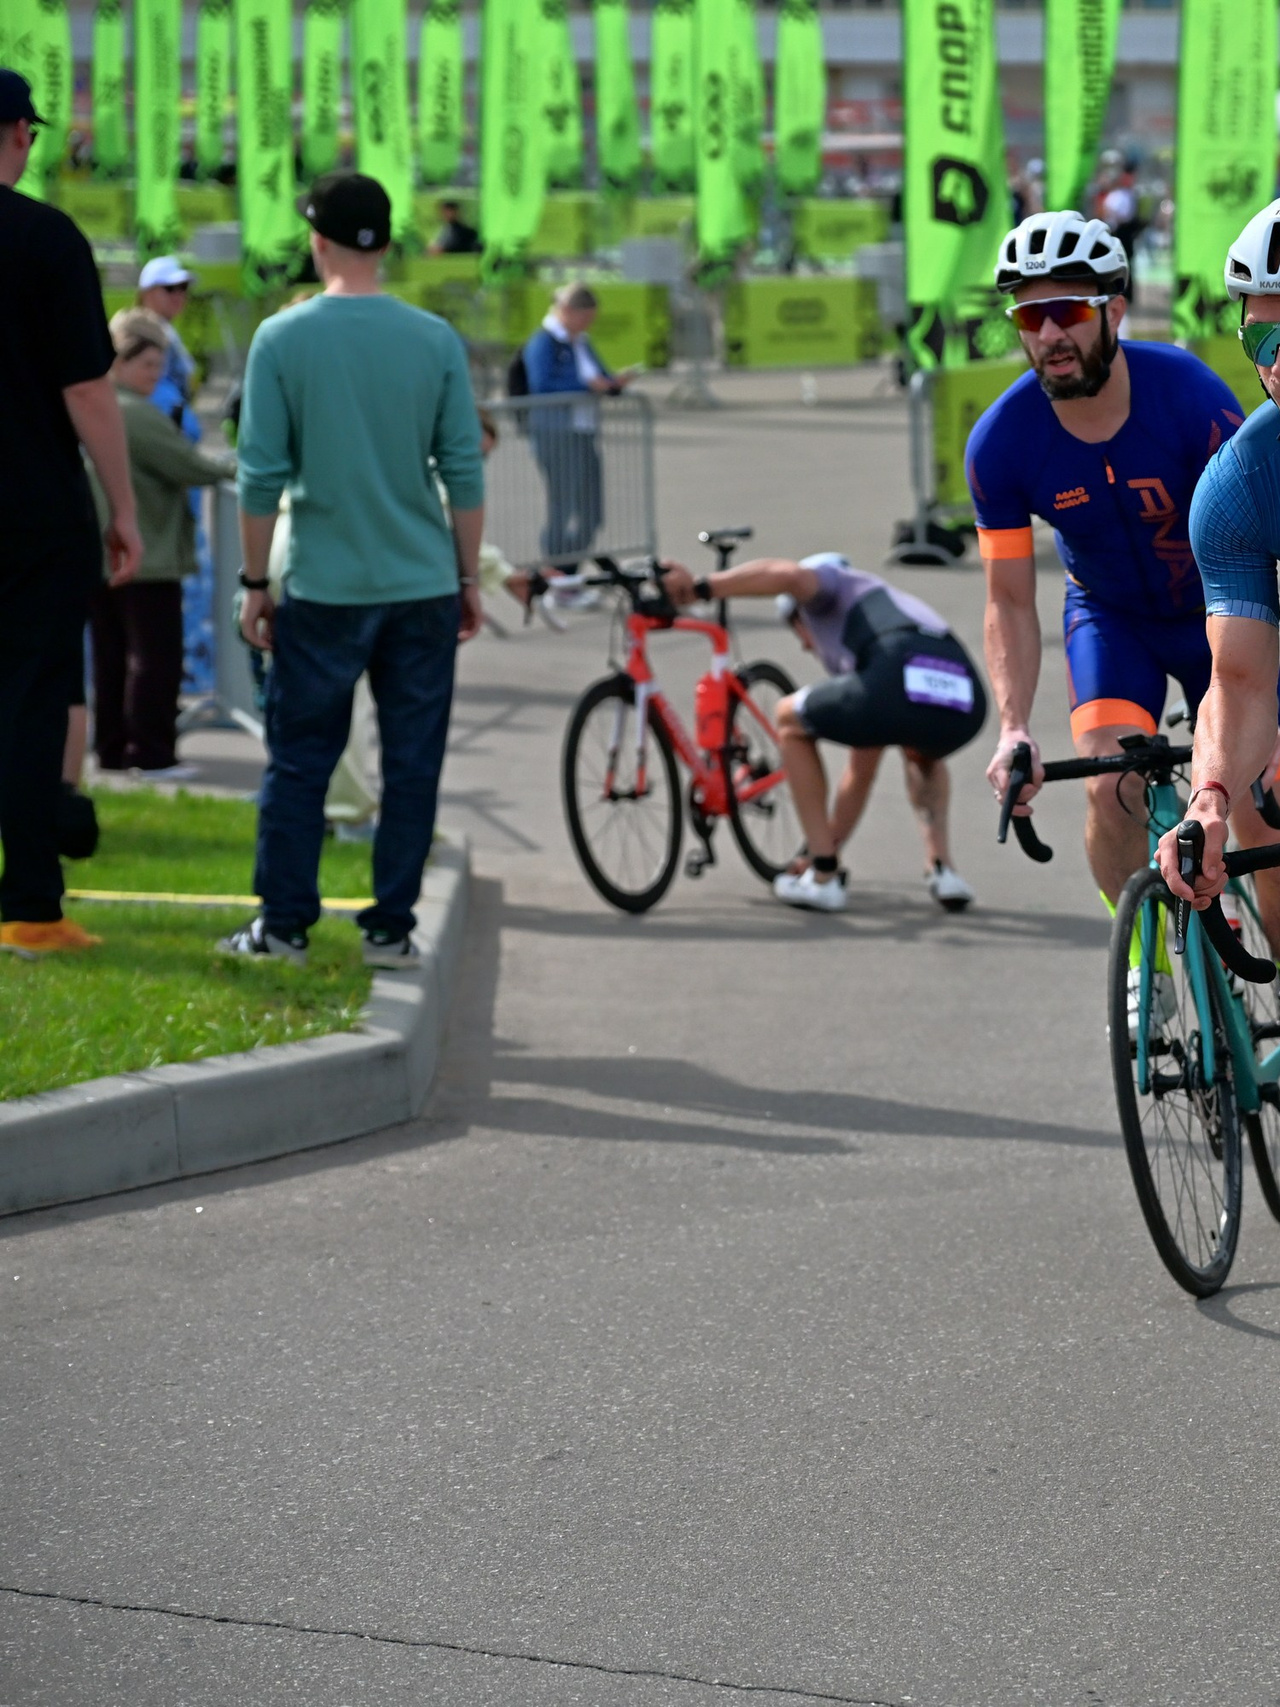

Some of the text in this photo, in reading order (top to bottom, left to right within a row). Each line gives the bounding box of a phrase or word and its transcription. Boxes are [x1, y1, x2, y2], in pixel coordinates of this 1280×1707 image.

[1025, 260, 1046, 270] 1200
[1259, 281, 1280, 289] KASK
[1056, 486, 1086, 501] MAD
[1053, 494, 1090, 510] WAVE
